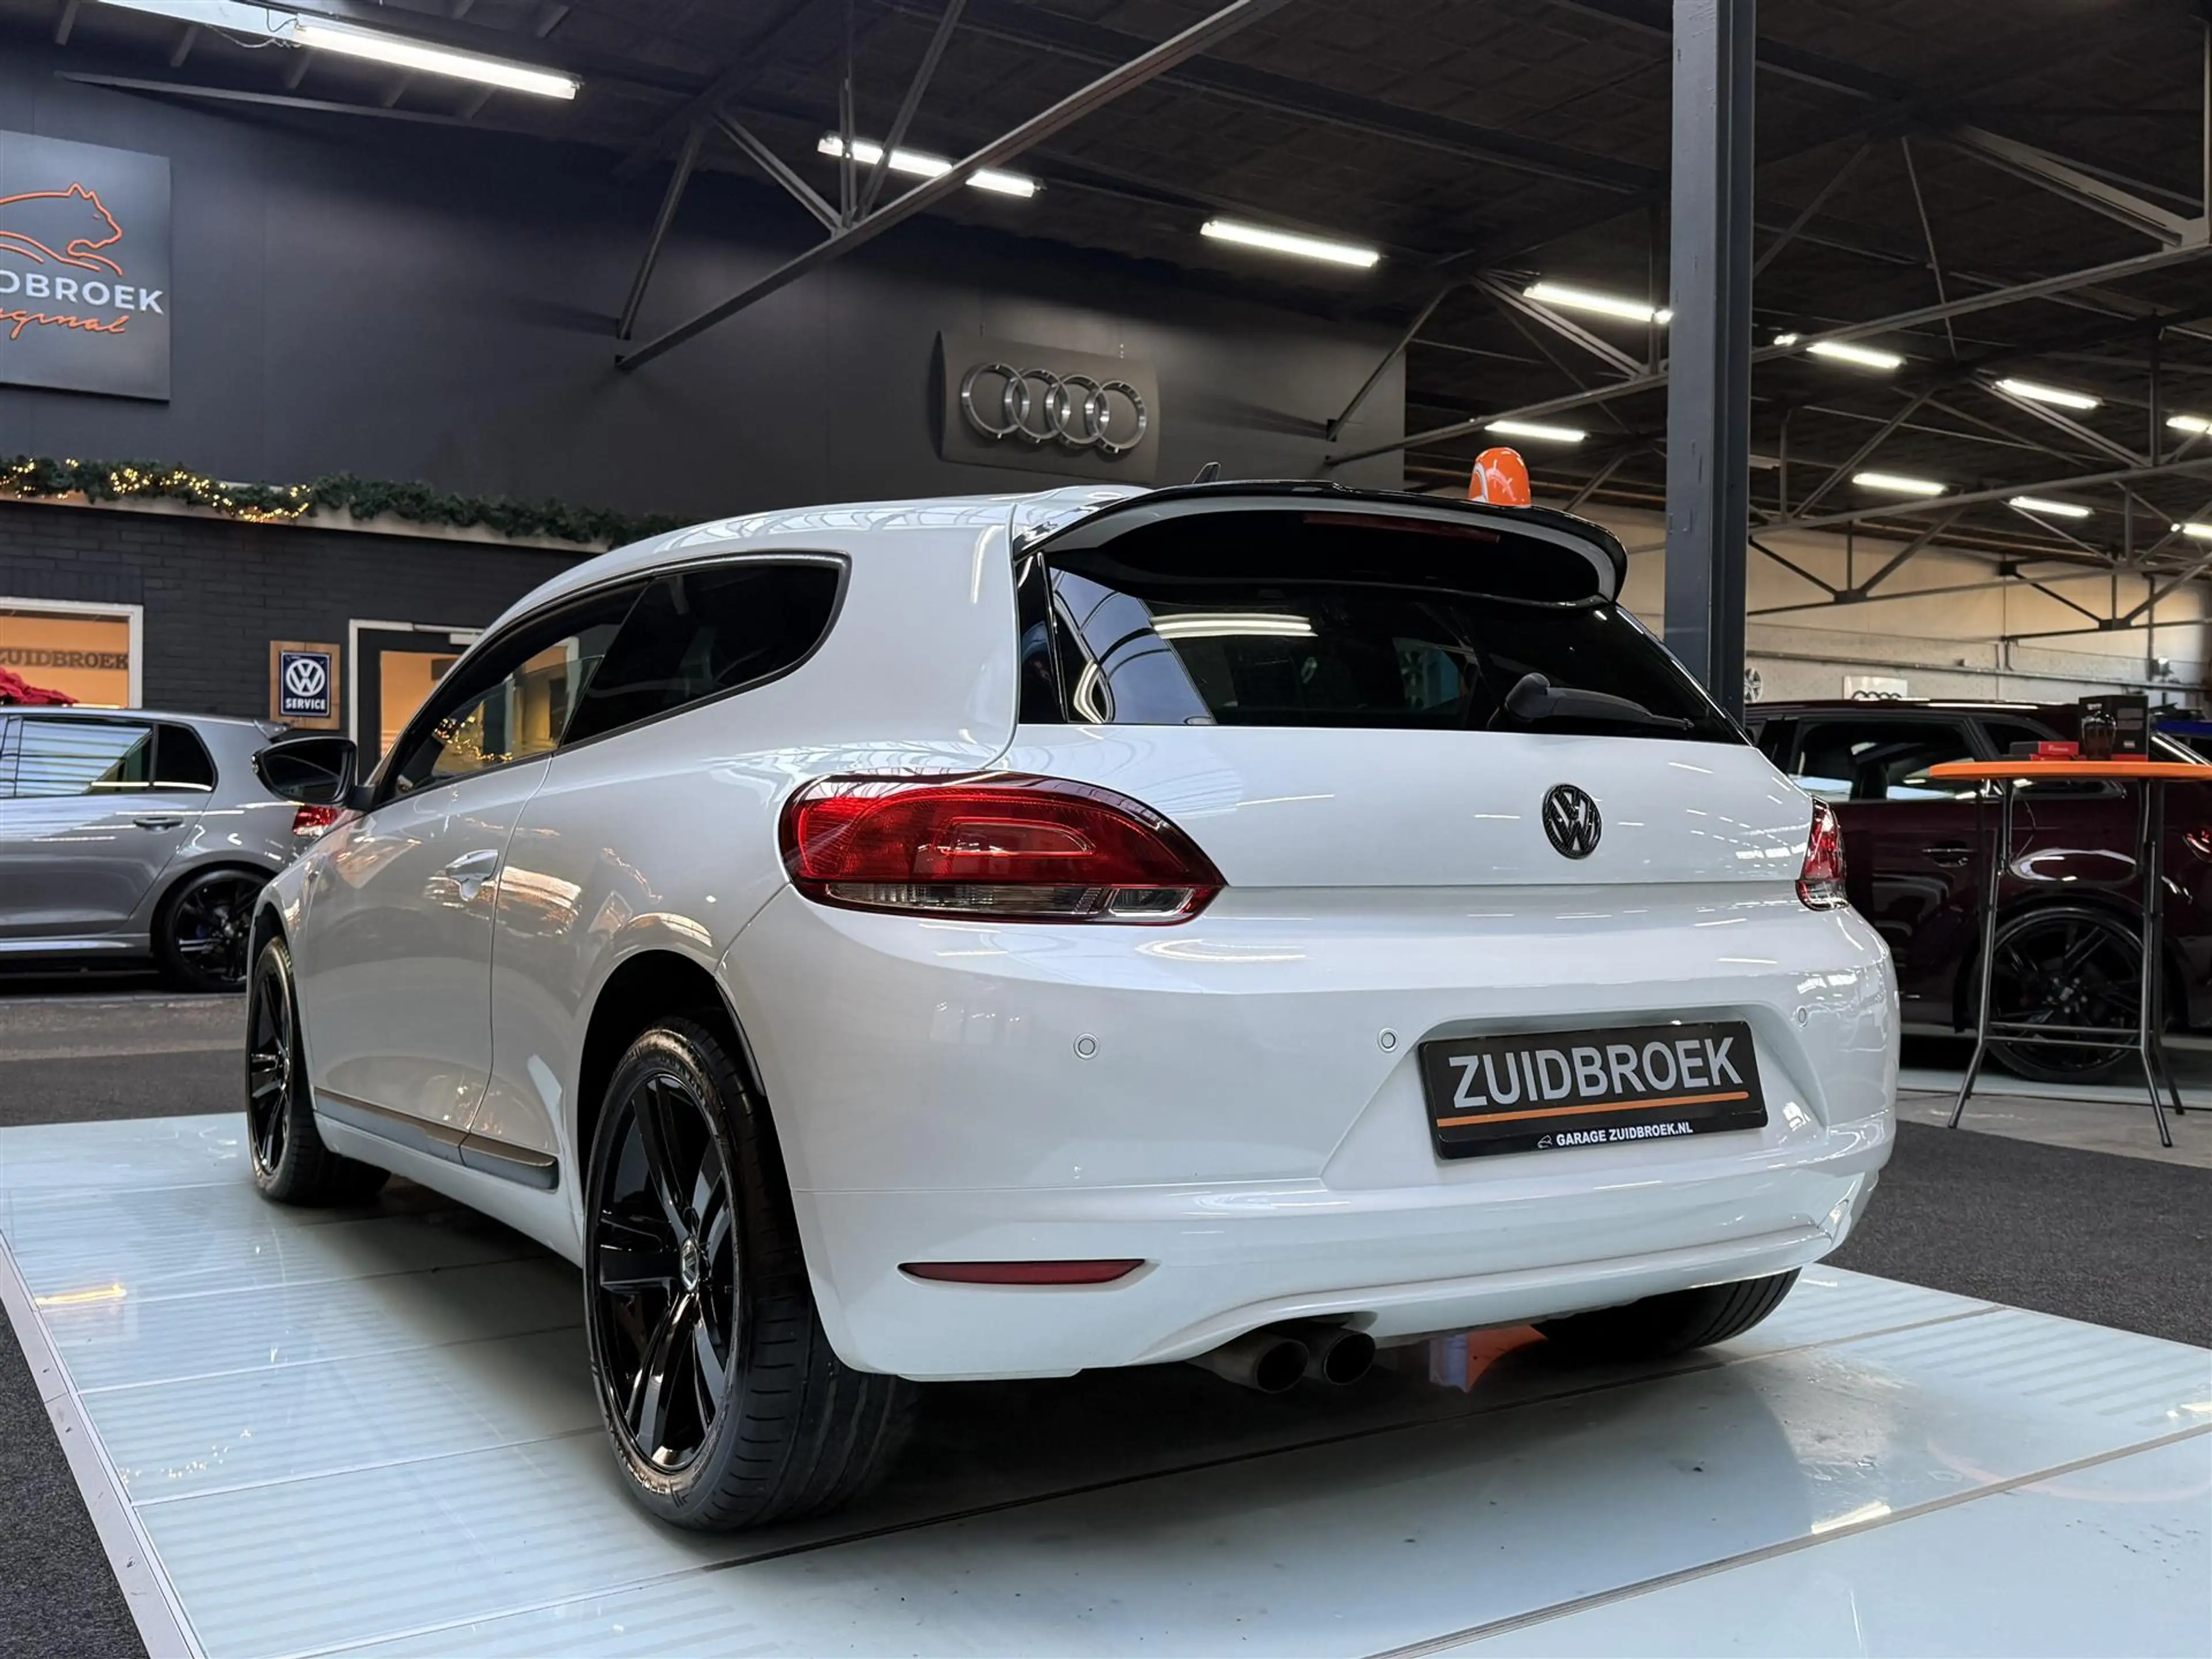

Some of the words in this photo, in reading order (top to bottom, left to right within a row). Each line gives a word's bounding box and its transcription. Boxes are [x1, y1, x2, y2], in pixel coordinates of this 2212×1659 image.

[285, 698, 325, 710] SERVICE
[1448, 1036, 1743, 1108] ZUIDBROEK
[1556, 1130, 1607, 1146] GARAGE
[1609, 1122, 1694, 1141] ZUIDBROEK.NL
